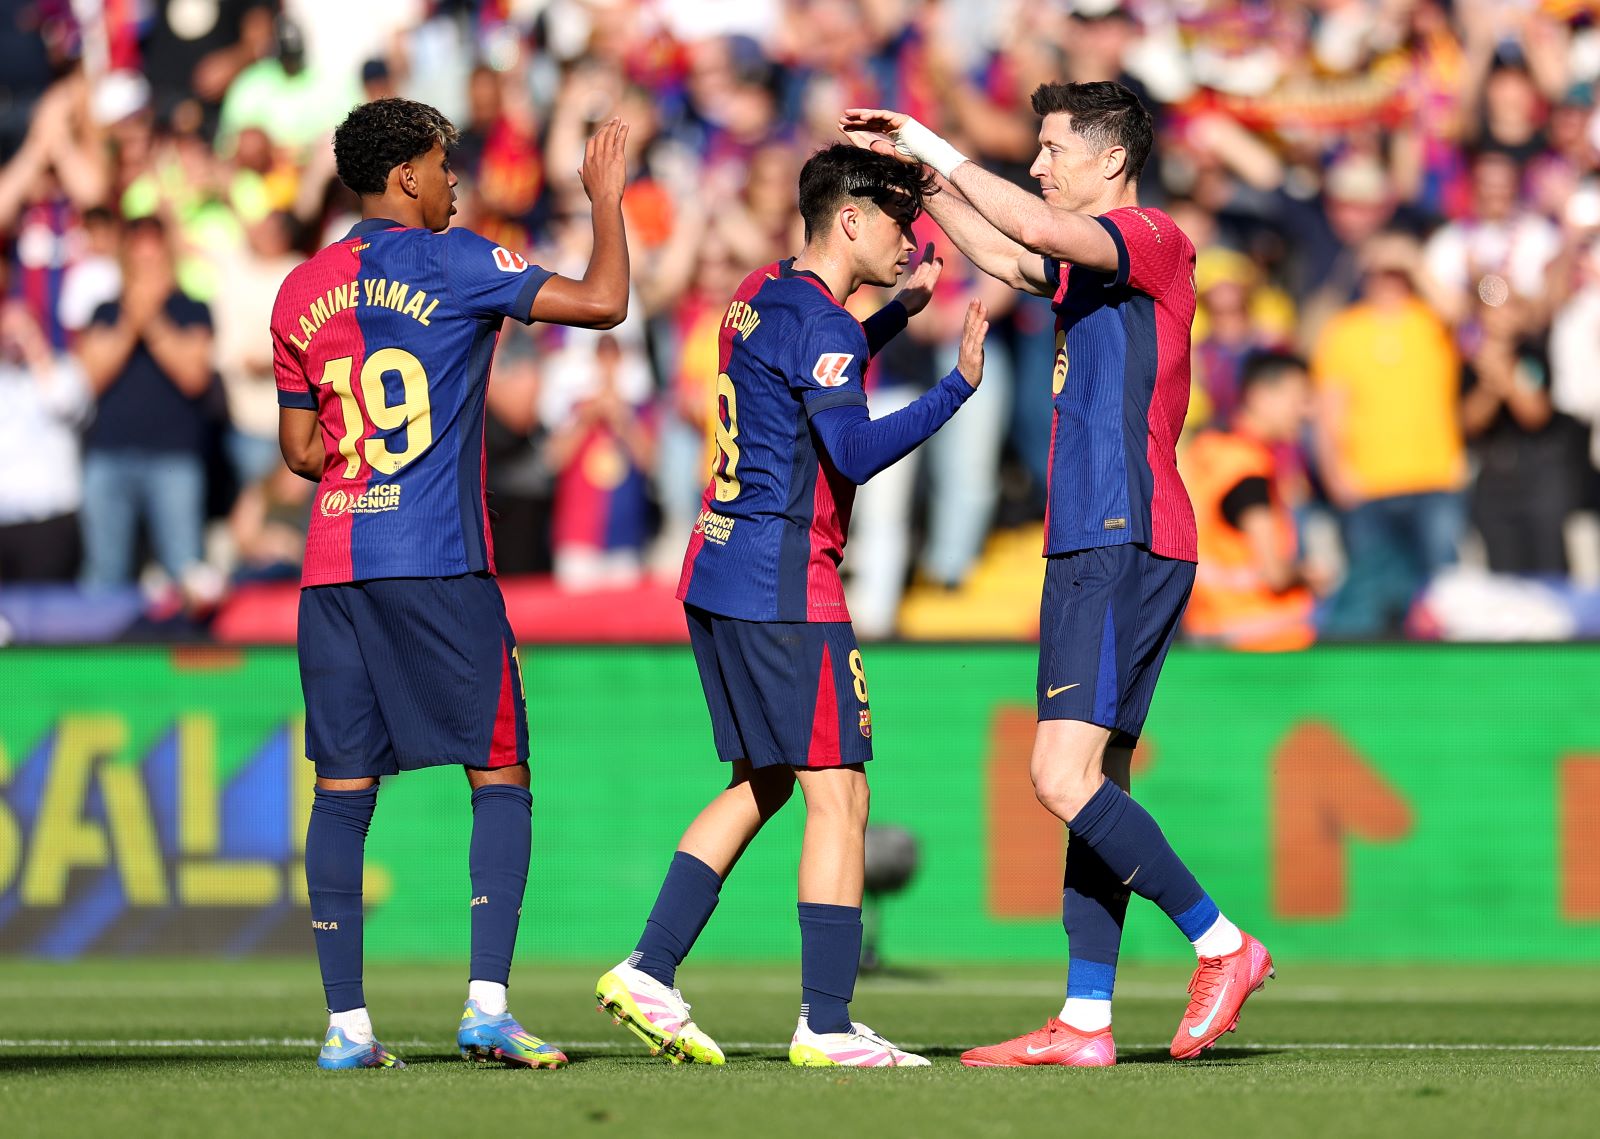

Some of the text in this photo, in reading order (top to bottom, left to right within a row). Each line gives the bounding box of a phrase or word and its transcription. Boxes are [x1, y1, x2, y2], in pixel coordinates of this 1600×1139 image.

[289, 278, 440, 352] LAMINE YAMAL
[724, 300, 761, 341] PEDRI
[318, 347, 433, 480] 19
[712, 372, 741, 503] 8
[366, 484, 401, 496] HCR
[703, 510, 735, 531] UNHCR
[703, 521, 731, 542] CNUR
[848, 648, 869, 704] 8
